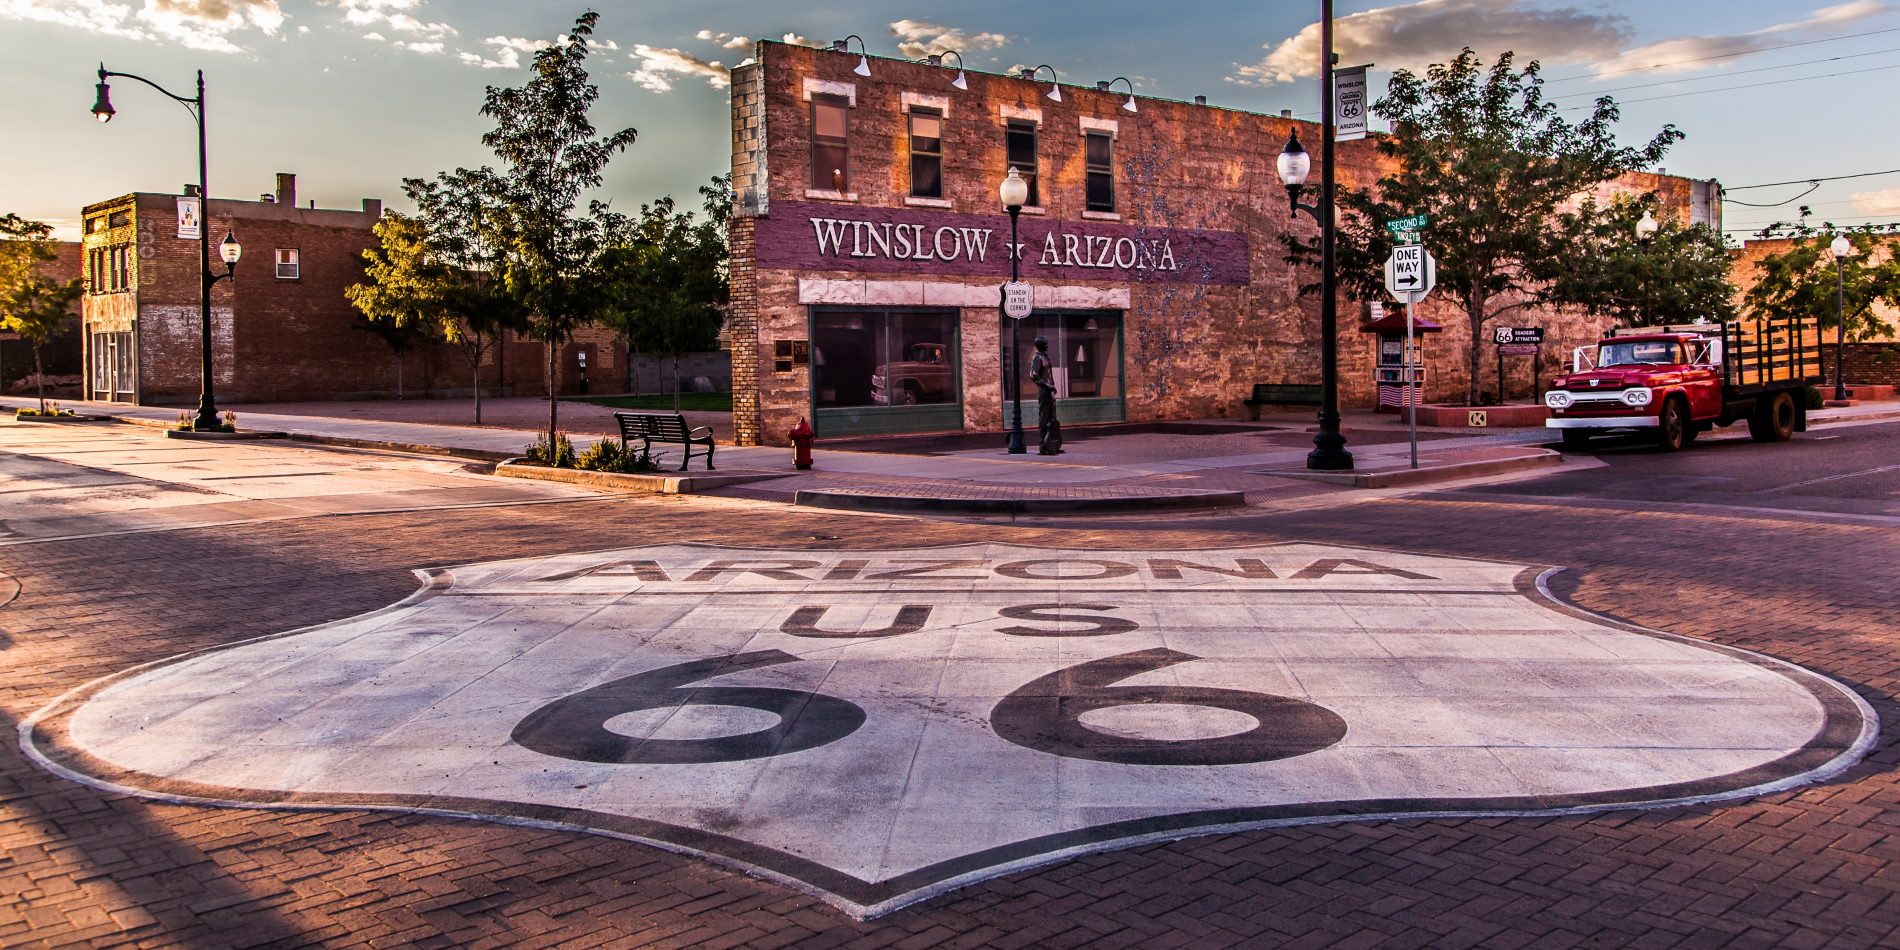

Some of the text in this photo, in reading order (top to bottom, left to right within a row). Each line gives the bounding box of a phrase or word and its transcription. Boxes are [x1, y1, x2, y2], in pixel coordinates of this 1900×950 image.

[1338, 81, 1364, 89] WINSLOW
[1344, 103, 1358, 115] 66
[1391, 217, 1418, 231] SECOND
[809, 217, 1177, 271] WINSLOW ARIZONA
[1396, 249, 1418, 261] ONE
[1396, 261, 1419, 273] WAY
[1498, 332, 1511, 342] 66
[534, 558, 1442, 582] ARIZONA
[509, 647, 1349, 766] 66
